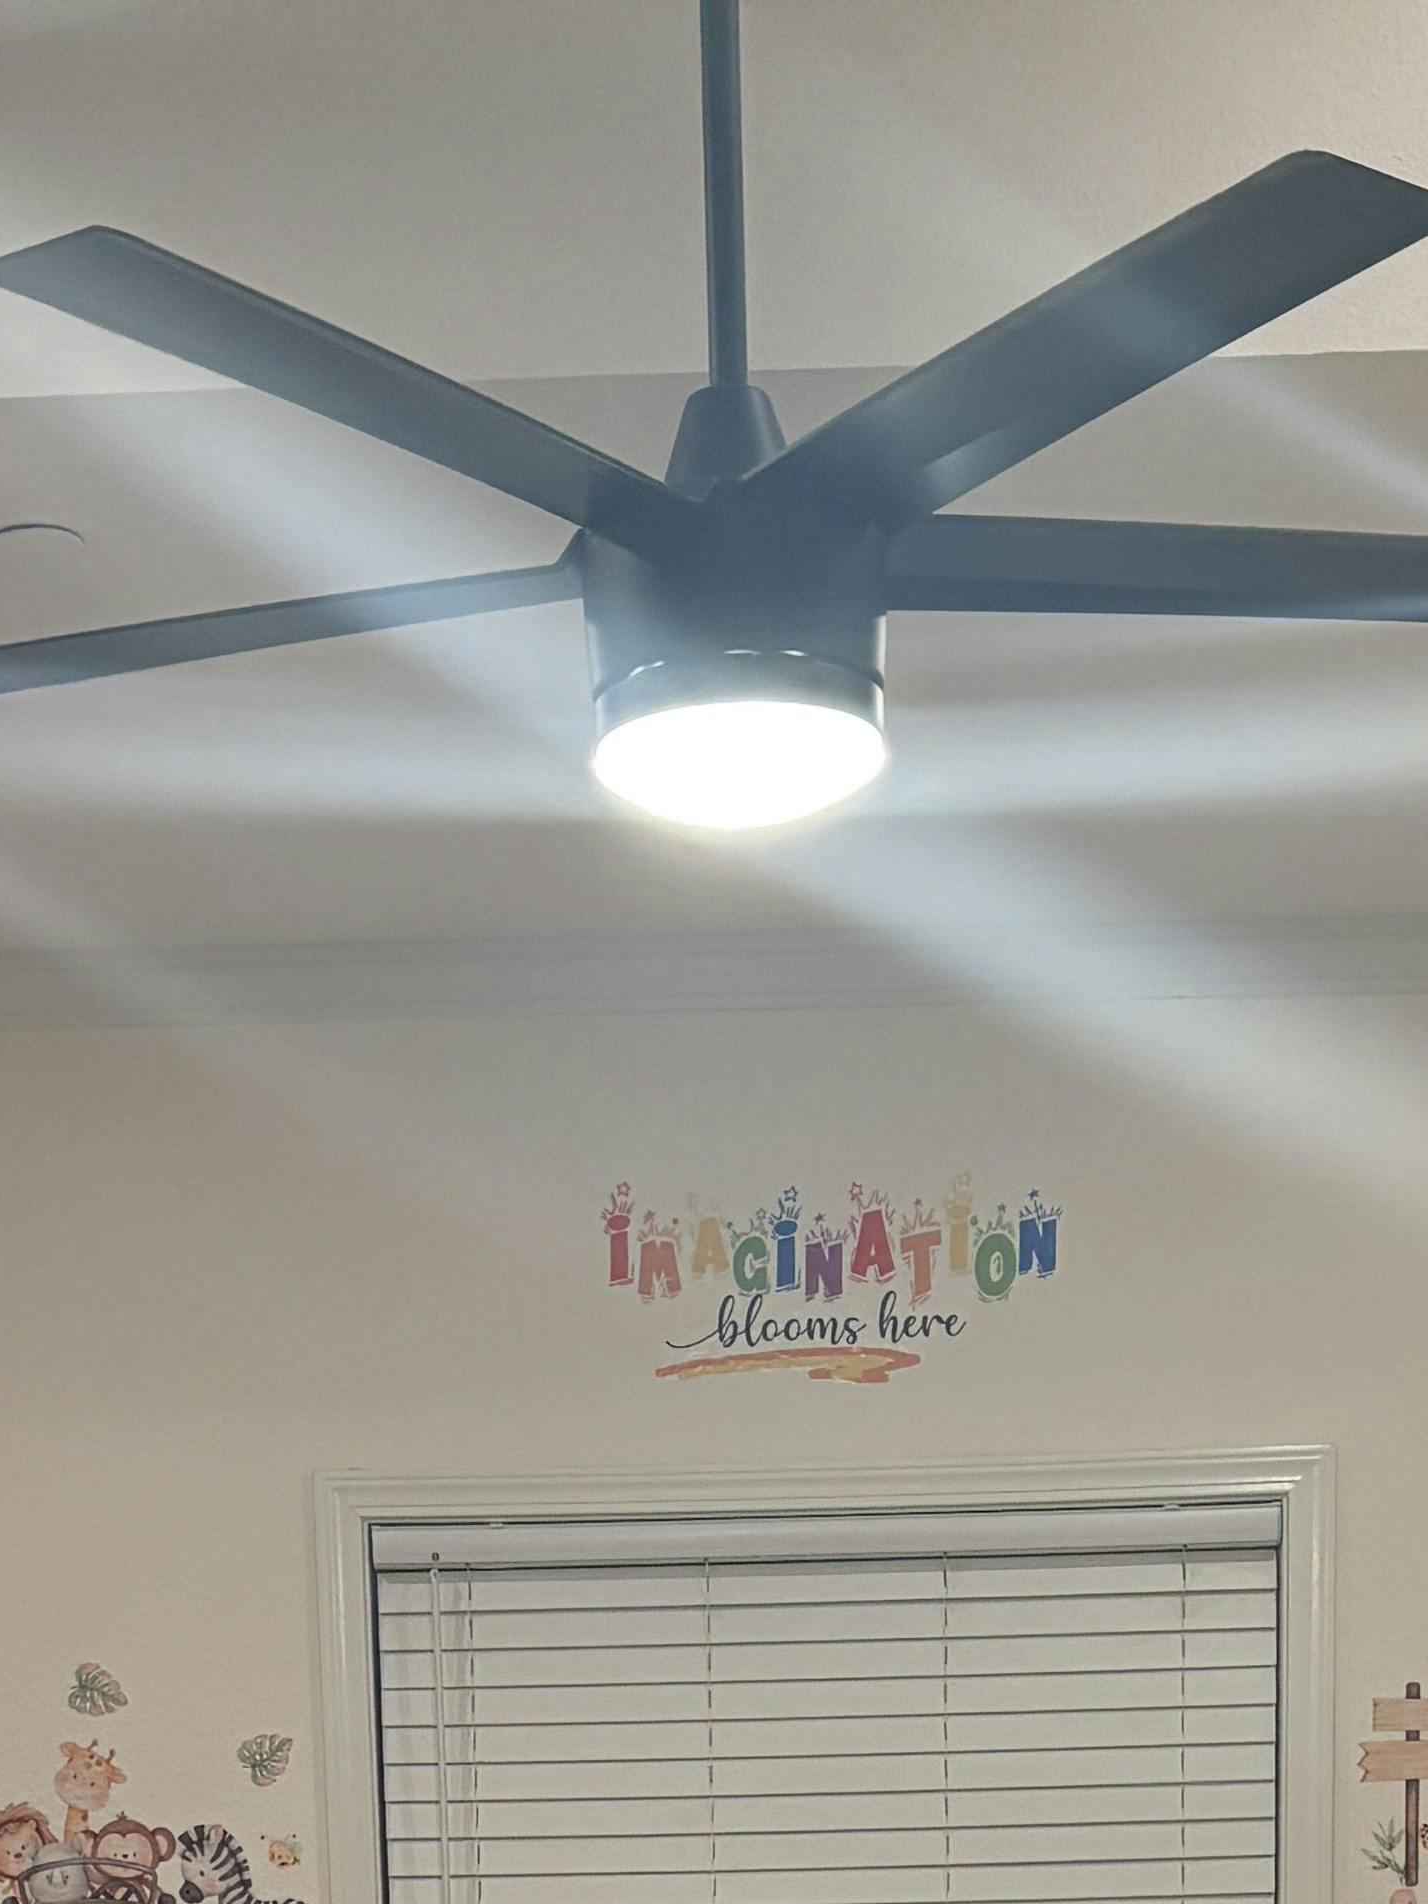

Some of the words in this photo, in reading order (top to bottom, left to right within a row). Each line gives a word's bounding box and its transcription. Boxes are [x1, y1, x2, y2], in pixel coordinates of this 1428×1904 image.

[602, 1188, 1060, 1304] IMAGINATION
[665, 1294, 866, 1349] blooms
[878, 1290, 967, 1339] here
